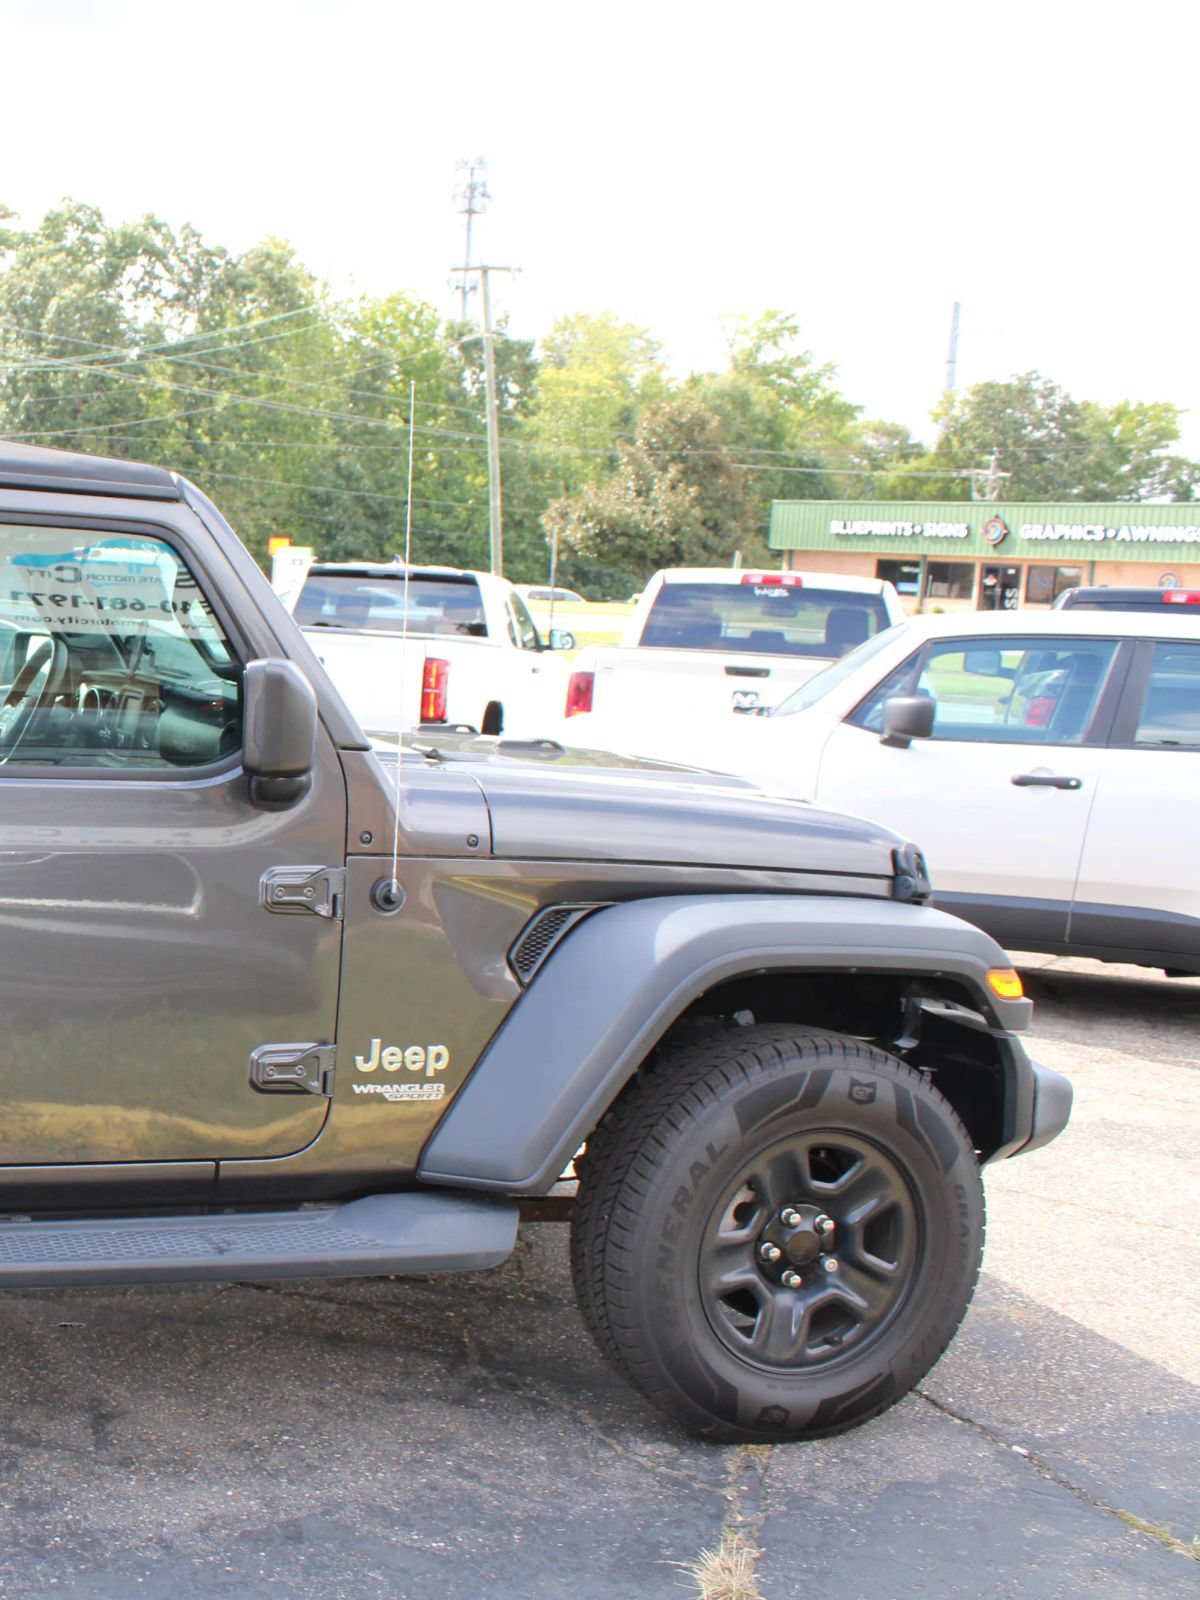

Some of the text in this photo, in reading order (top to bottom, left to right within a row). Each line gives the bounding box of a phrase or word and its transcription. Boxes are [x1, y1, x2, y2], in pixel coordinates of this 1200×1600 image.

[830, 520, 968, 538] BLUEPRINTS SIGNS
[1020, 524, 1105, 541] GRAPHICS
[355, 1038, 449, 1076] Jeep
[352, 1083, 445, 1094] WRANGLER
